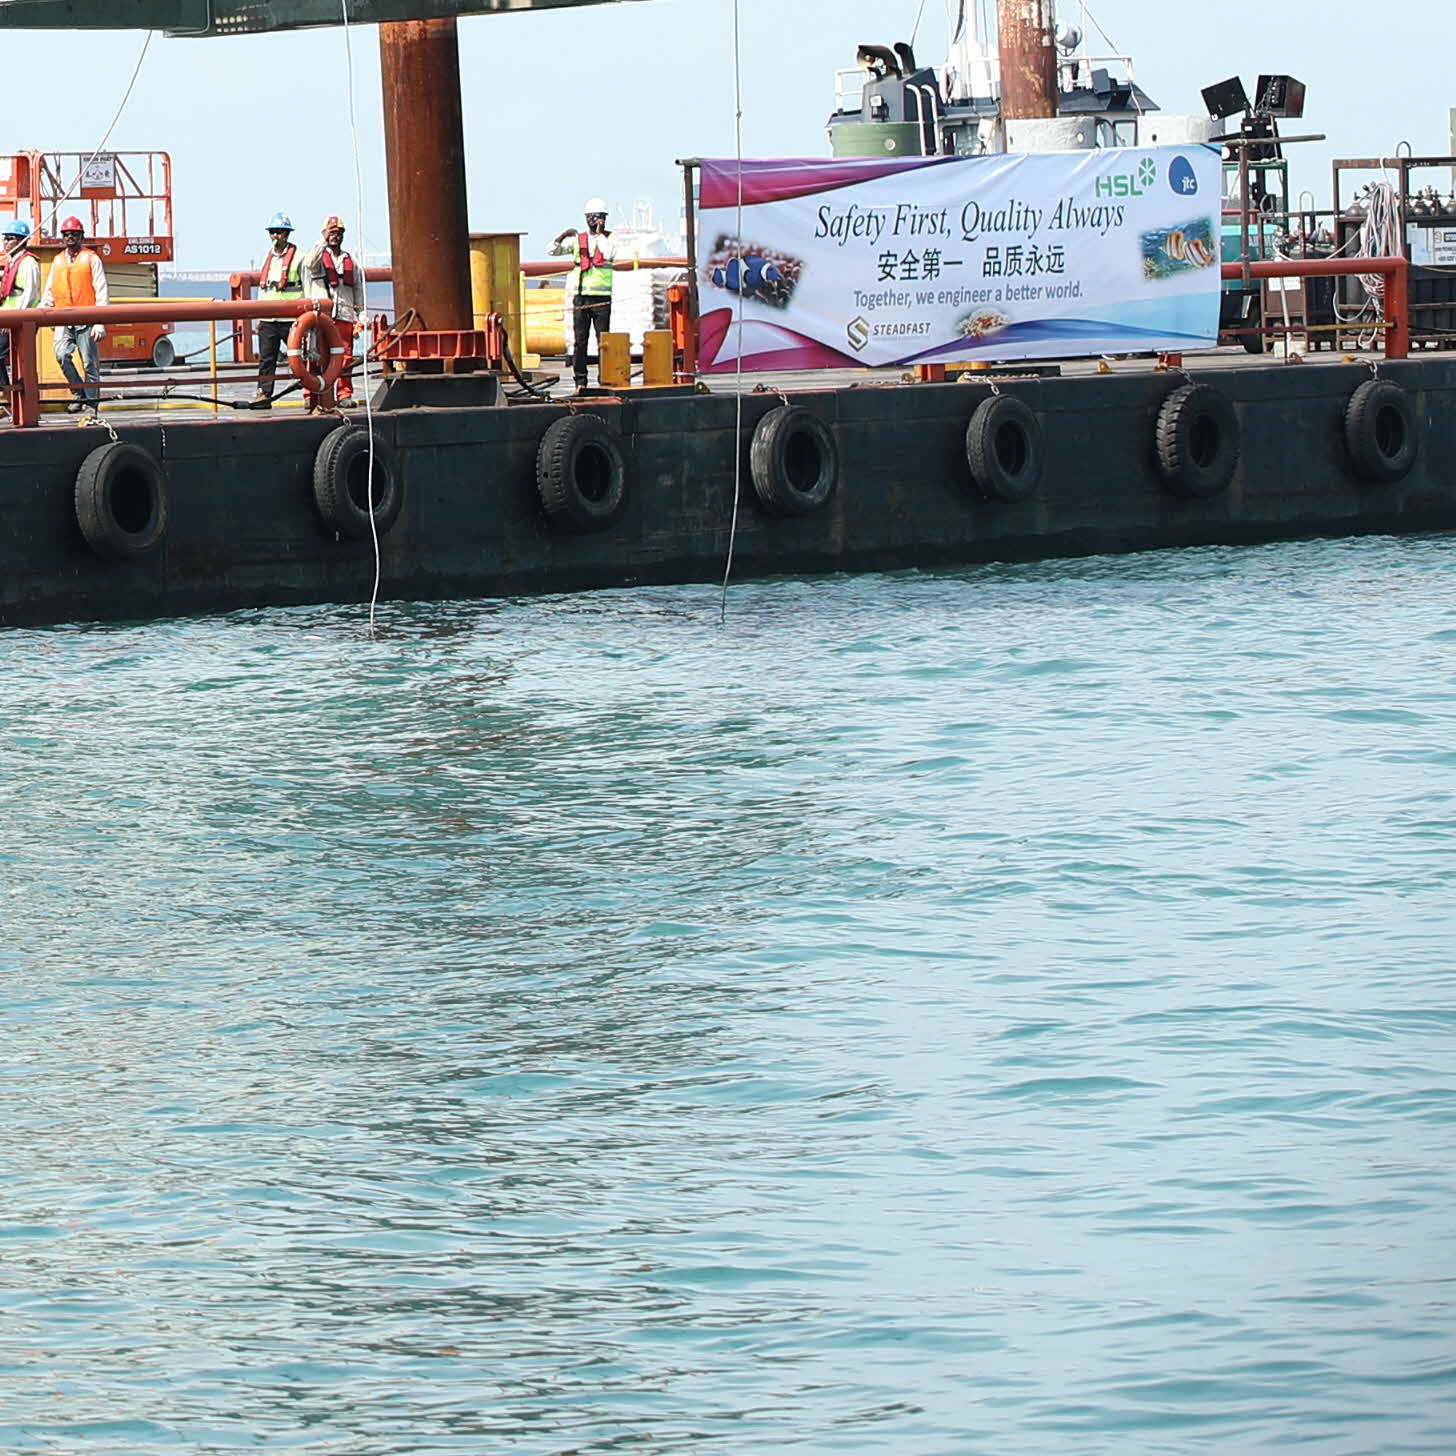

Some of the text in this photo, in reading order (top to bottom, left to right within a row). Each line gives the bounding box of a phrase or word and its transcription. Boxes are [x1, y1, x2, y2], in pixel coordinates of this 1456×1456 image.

[1095, 175, 1144, 197] HSL
[814, 197, 1125, 247] Safety First, Quality Always
[124, 244, 161, 254] AS1012
[877, 244, 1065, 282] 安全第一 品质永远
[853, 281, 1083, 311] Together, we engineer a better world.
[873, 322, 931, 337] STEADFAST
